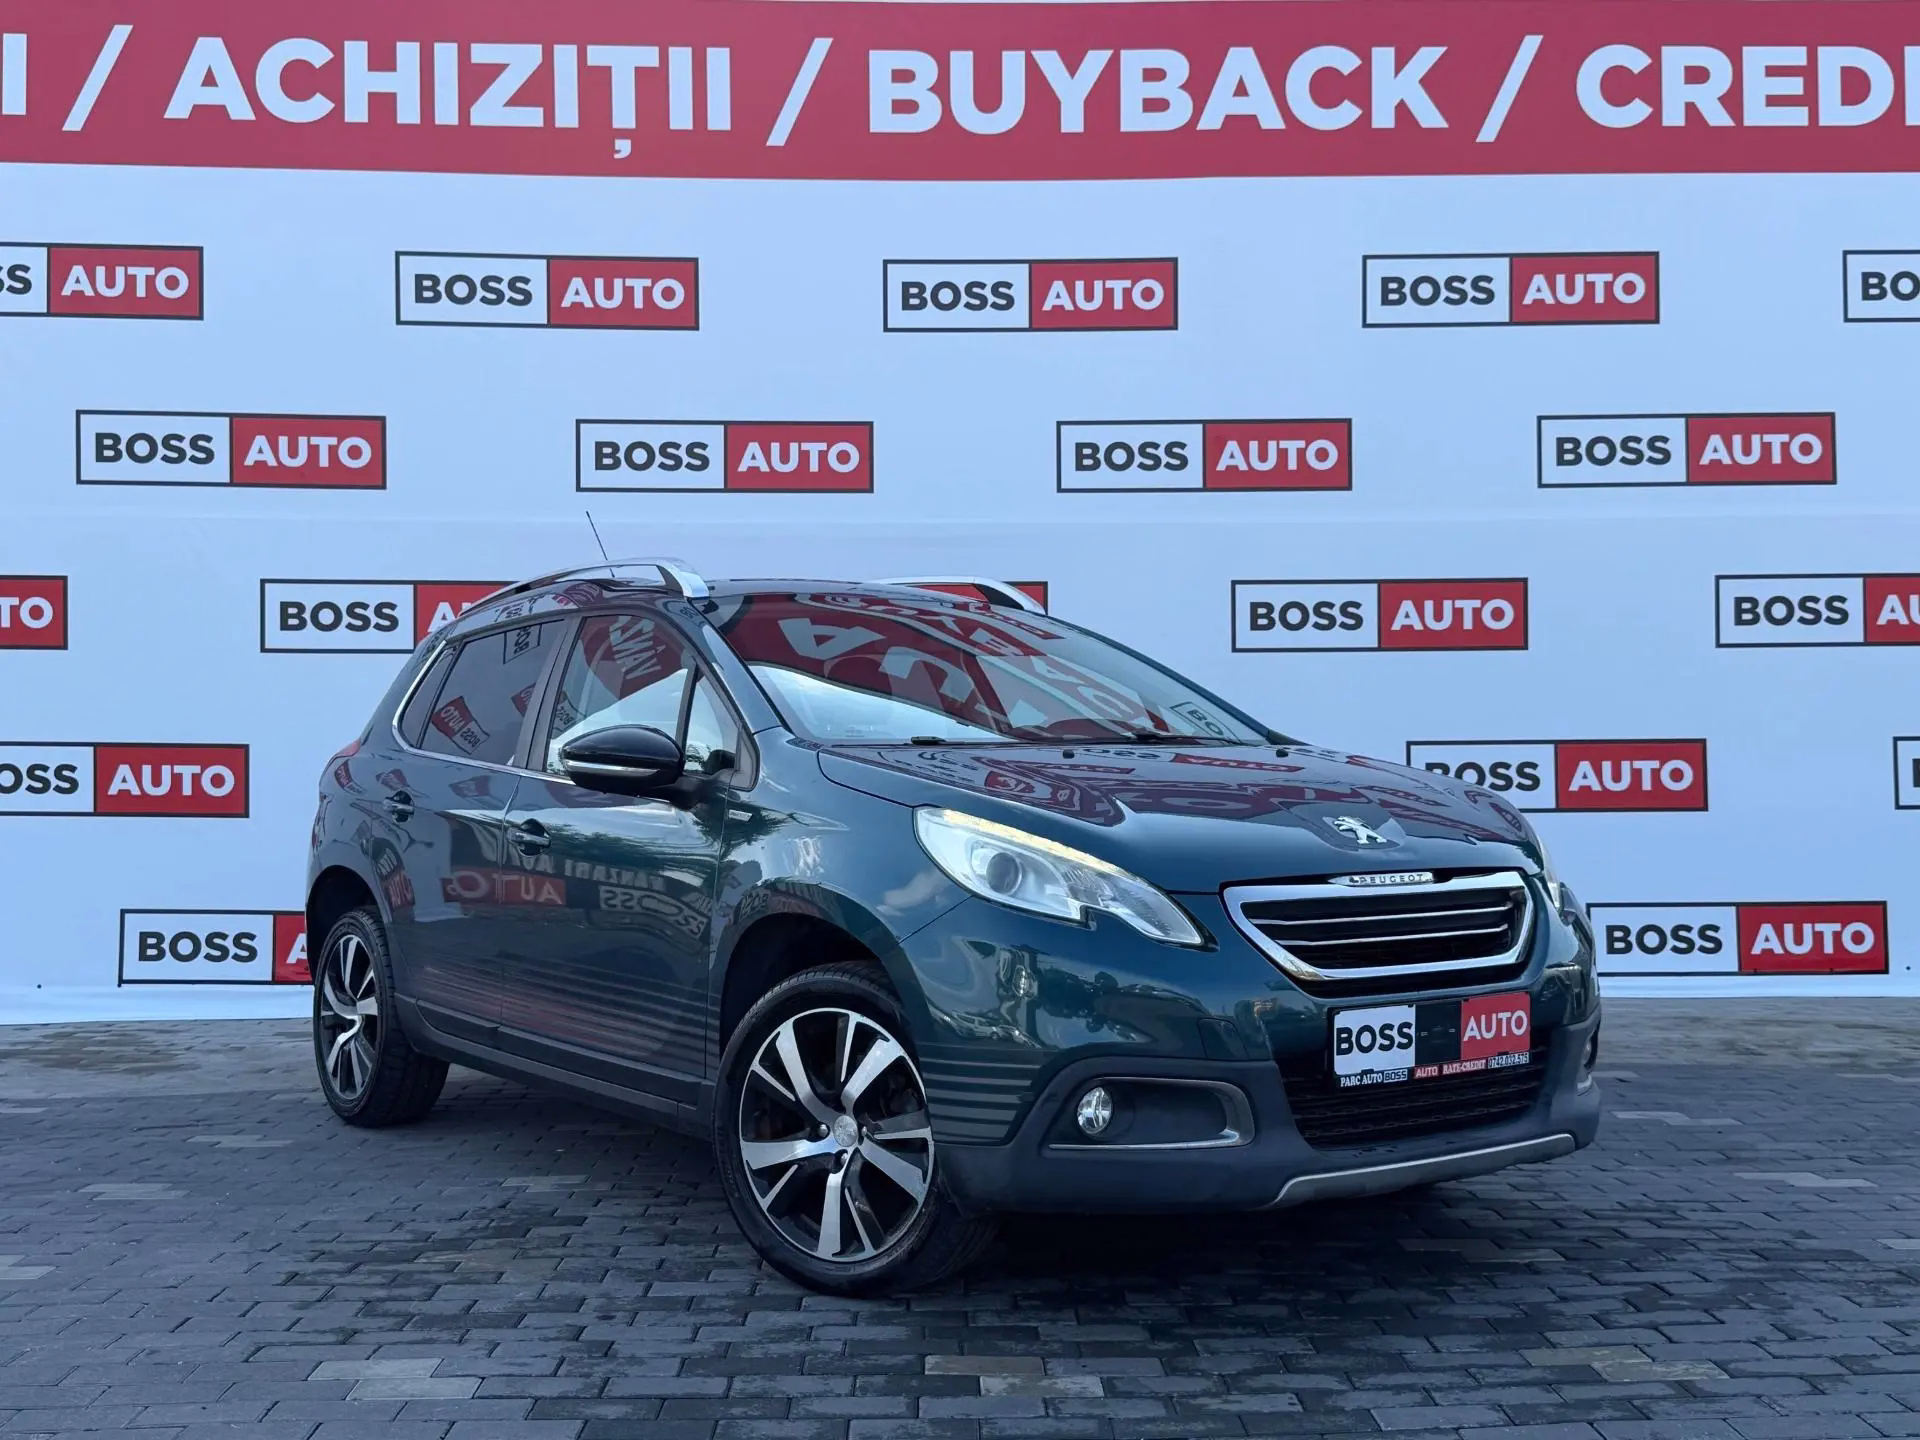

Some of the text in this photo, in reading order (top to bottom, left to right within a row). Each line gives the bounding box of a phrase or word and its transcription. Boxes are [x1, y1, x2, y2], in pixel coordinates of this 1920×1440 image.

[164, 37, 731, 158] ACHIZIȚII
[869, 46, 1449, 134] BUYBACK
[62, 265, 188, 298] AUTO
[415, 274, 684, 309] BOSS AUTO
[902, 279, 1164, 311] BOSS AUTO
[1382, 273, 1645, 306] BOSS AUTO
[96, 433, 371, 468] BOSS AUTO
[595, 442, 860, 473] BOSS AUTO
[1076, 440, 1338, 472] BOSS AUTO
[1557, 434, 1822, 466] BOSS AUTO
[280, 602, 399, 632] BOSS
[1250, 599, 1514, 632] BOSS AUTO
[1735, 596, 1849, 626] BOSS
[108, 764, 235, 797] AUTO
[1570, 759, 1693, 791] AUTO
[1360, 873, 1423, 884] PEUGEOT
[139, 931, 258, 963] BOSS
[1606, 922, 1874, 955] BOSS AUTO
[1335, 1010, 1528, 1056] BOSS AUTO
[1340, 1076, 1361, 1087] PARC
[1361, 1073, 1383, 1085] AUTO
[1384, 1070, 1407, 1082] BOSS
[1415, 1066, 1438, 1078] AUTO
